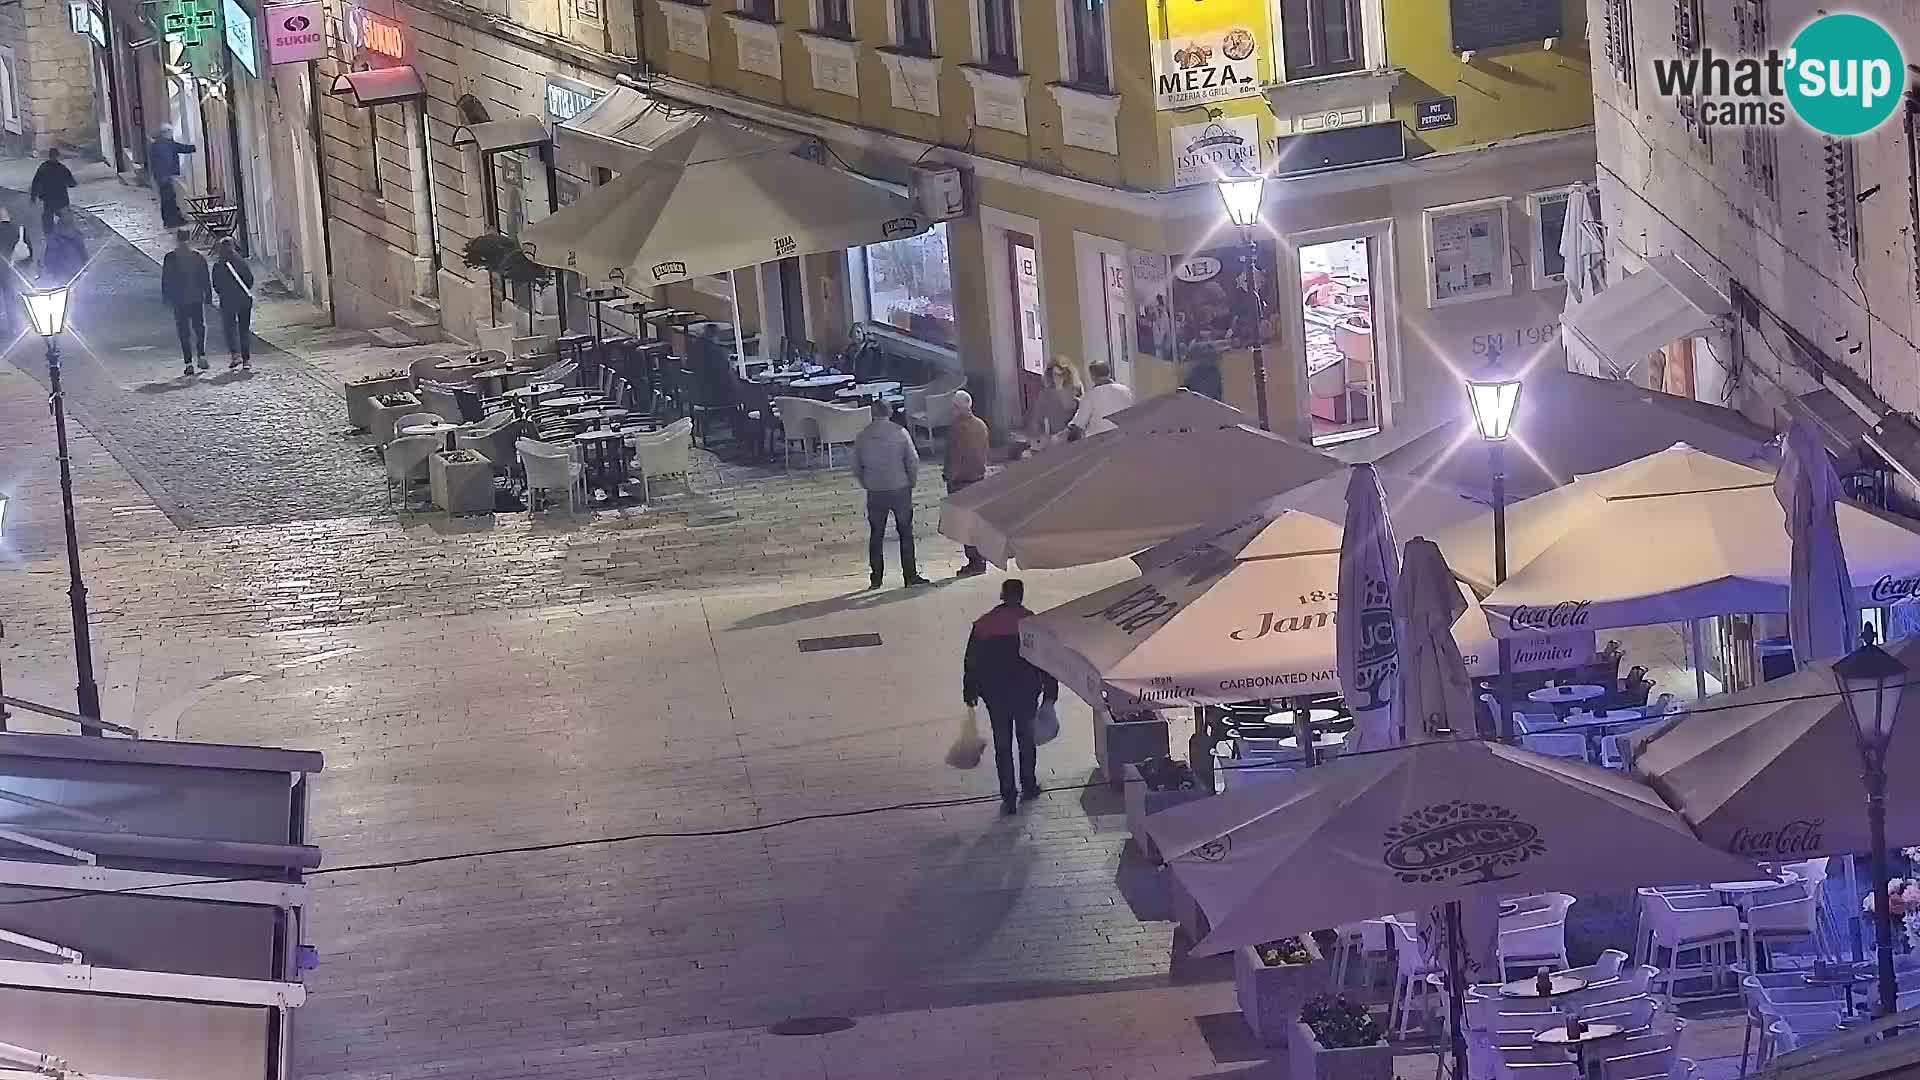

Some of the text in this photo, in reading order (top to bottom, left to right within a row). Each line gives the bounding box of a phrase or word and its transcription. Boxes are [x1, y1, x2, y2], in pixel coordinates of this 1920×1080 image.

[276, 33, 320, 47] SUKNO
[363, 17, 402, 59] SUKNO
[1159, 64, 1238, 95] MEZA
[1168, 91, 1200, 103] PIZZERIA
[1208, 87, 1229, 96] GRILL
[1177, 150, 1223, 169] ISPOD
[1515, 323, 1561, 347] 198
[1219, 672, 1308, 690] CARBONATED
